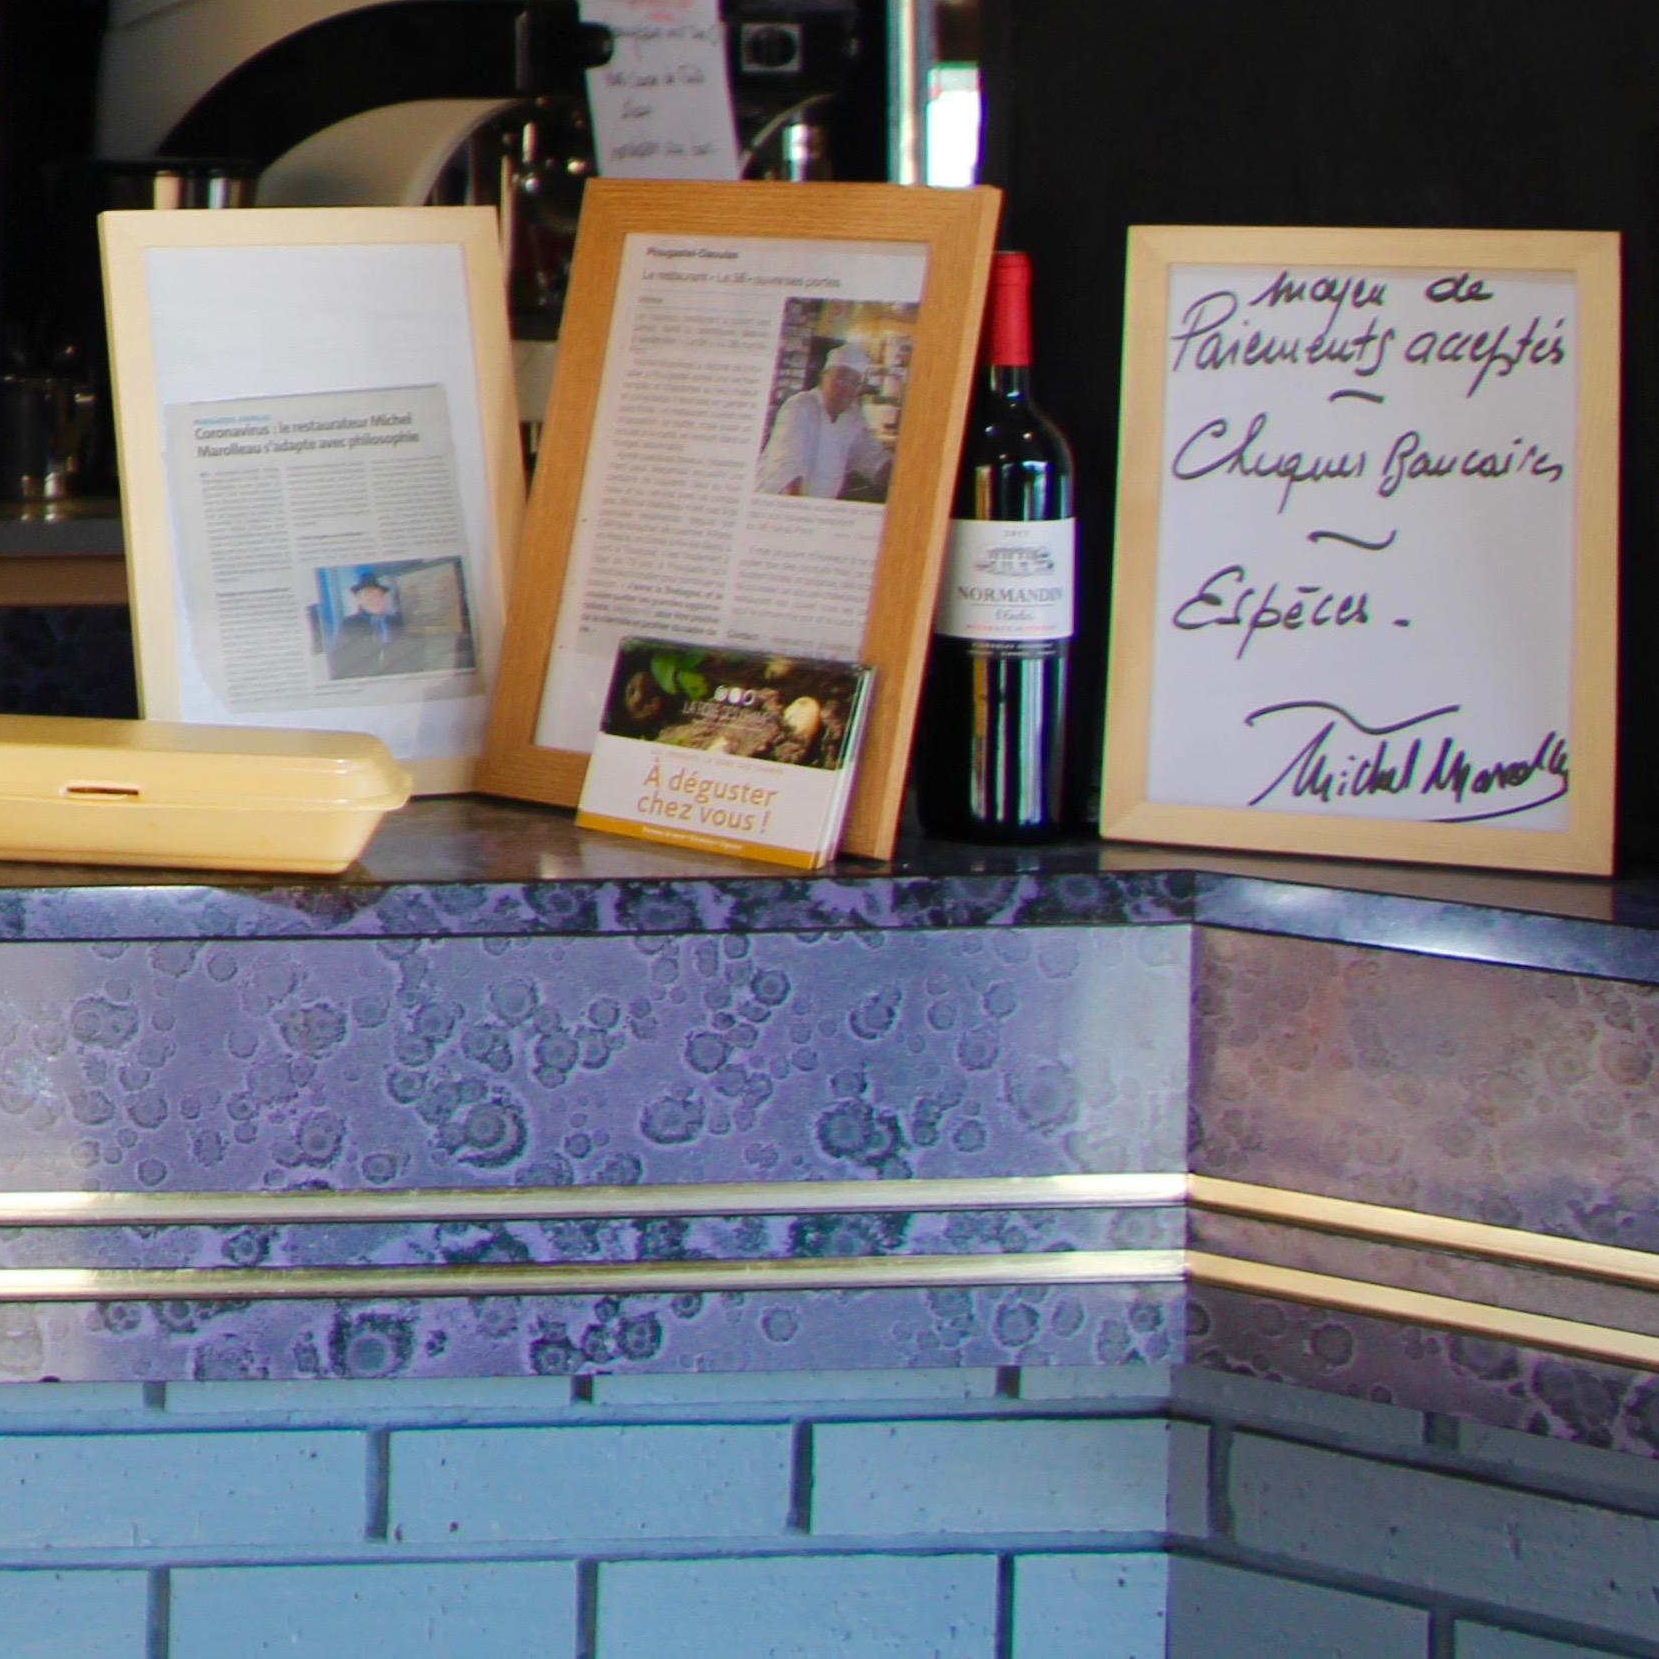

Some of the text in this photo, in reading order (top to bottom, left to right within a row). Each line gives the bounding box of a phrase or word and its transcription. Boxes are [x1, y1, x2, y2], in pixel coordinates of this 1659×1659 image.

[1424, 271, 1495, 305] de
[1171, 290, 1394, 376] Paiements
[195, 412, 412, 440] Coronavirus le restaurateur Michel
[319, 437, 346, 449] avec
[348, 431, 419, 450] philosophie
[642, 757, 660, 787] À
[668, 767, 777, 808] déguster
[637, 790, 771, 834] chez vous !
